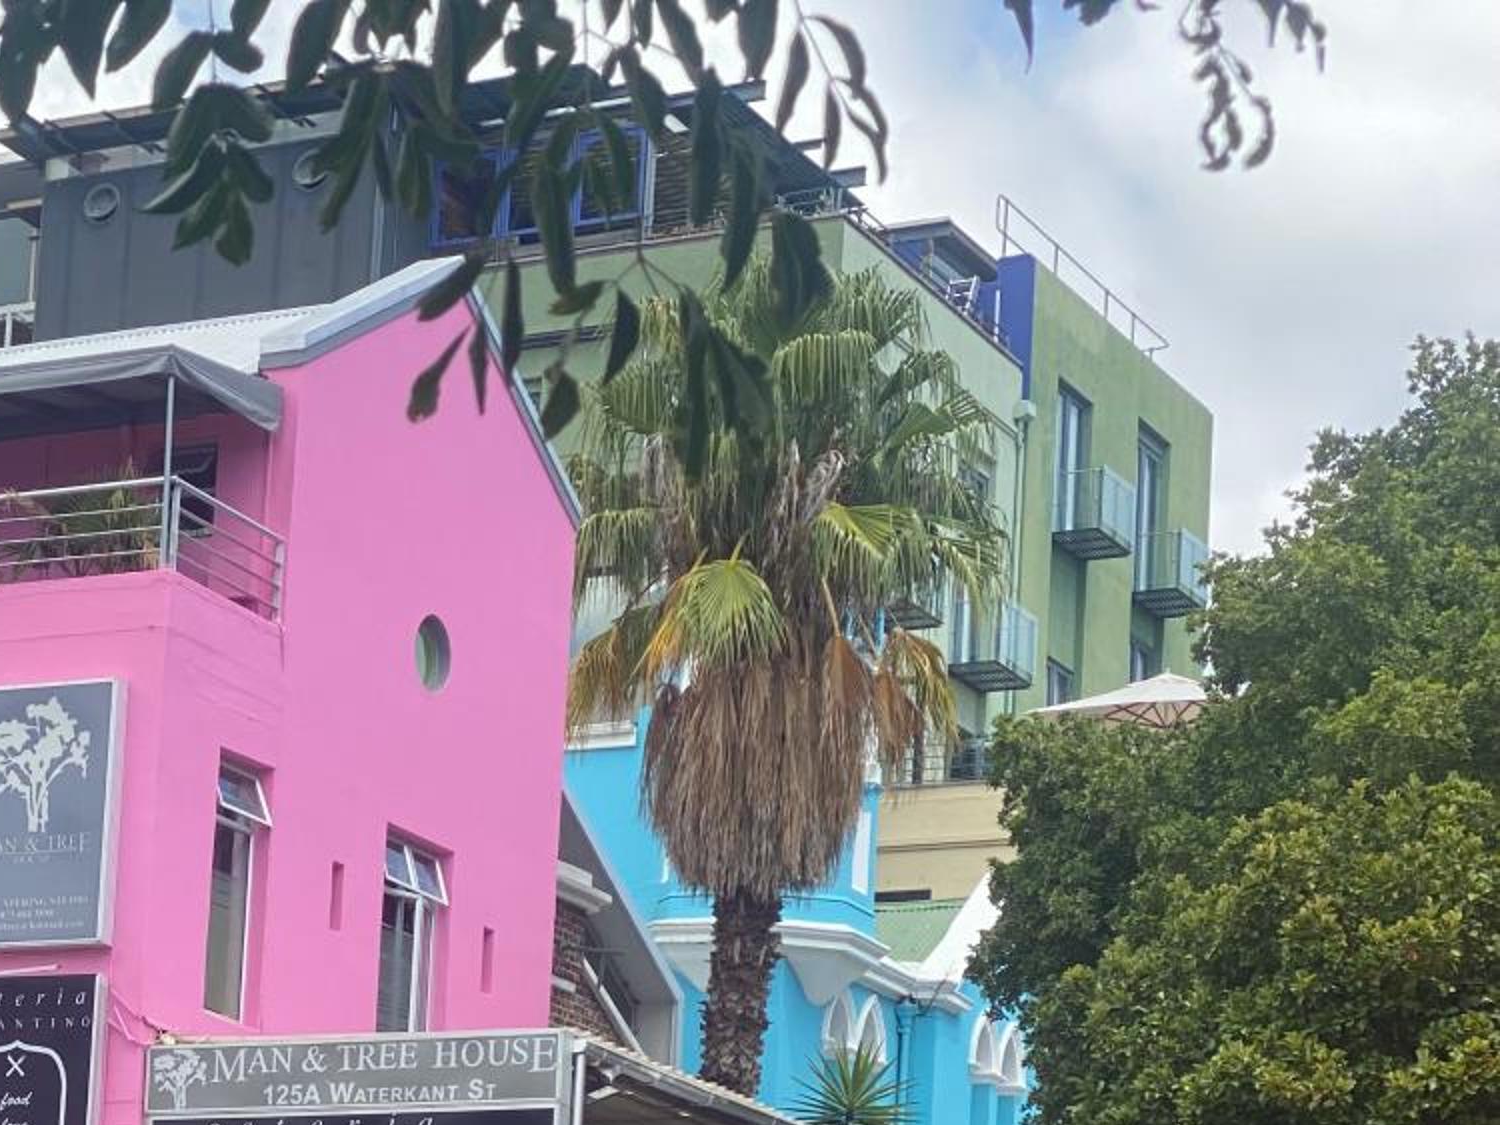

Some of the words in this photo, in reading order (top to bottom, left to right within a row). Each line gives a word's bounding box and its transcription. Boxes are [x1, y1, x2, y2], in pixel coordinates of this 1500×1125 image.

[213, 1048, 293, 1083] MAN
[302, 1048, 327, 1072] &
[338, 1045, 418, 1071] TREE
[435, 1037, 559, 1073] HOUSE
[0, 1092, 33, 1111] food
[263, 1084, 320, 1105] 125A
